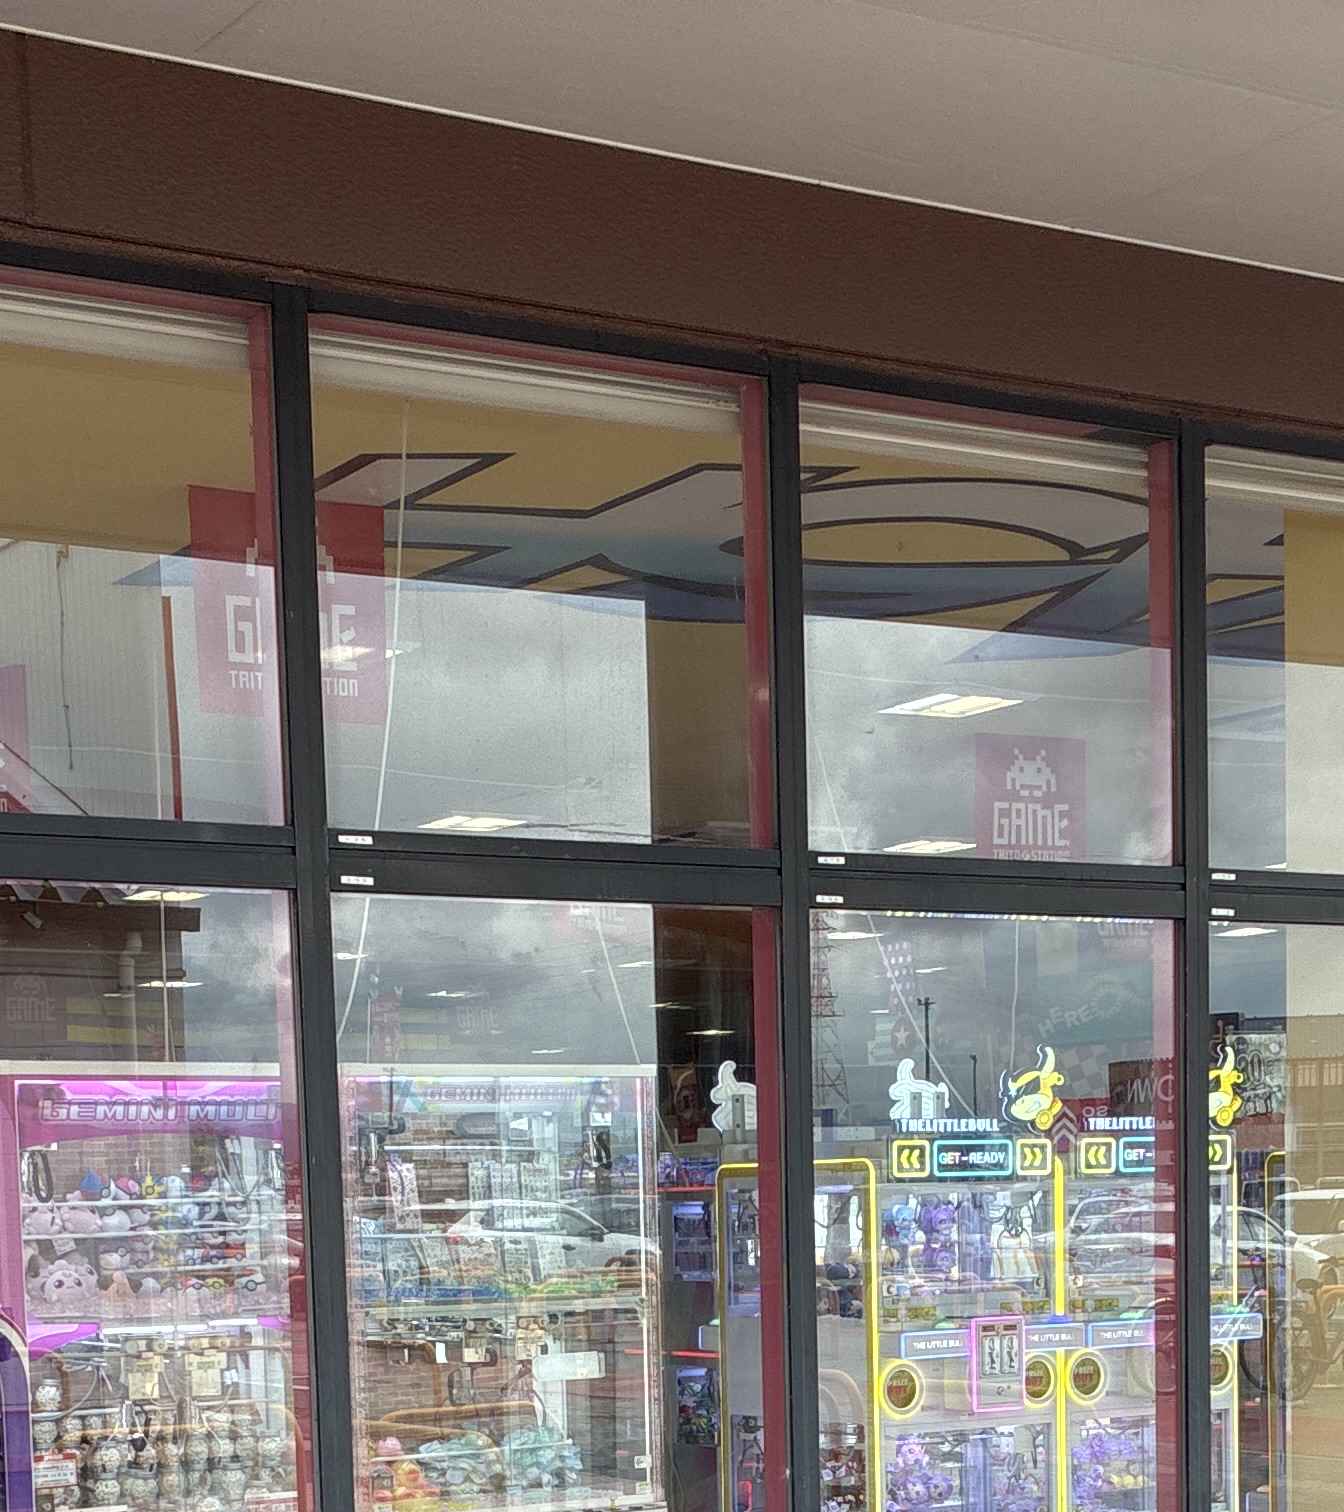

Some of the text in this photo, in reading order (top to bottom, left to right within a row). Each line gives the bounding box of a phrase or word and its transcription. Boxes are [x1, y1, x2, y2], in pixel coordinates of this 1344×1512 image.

[228, 670, 263, 691] TAIT
[993, 801, 1070, 847] GAME
[41, 1097, 279, 1123] GEMINI MULT
[938, 1151, 1006, 1165] GET-READY
